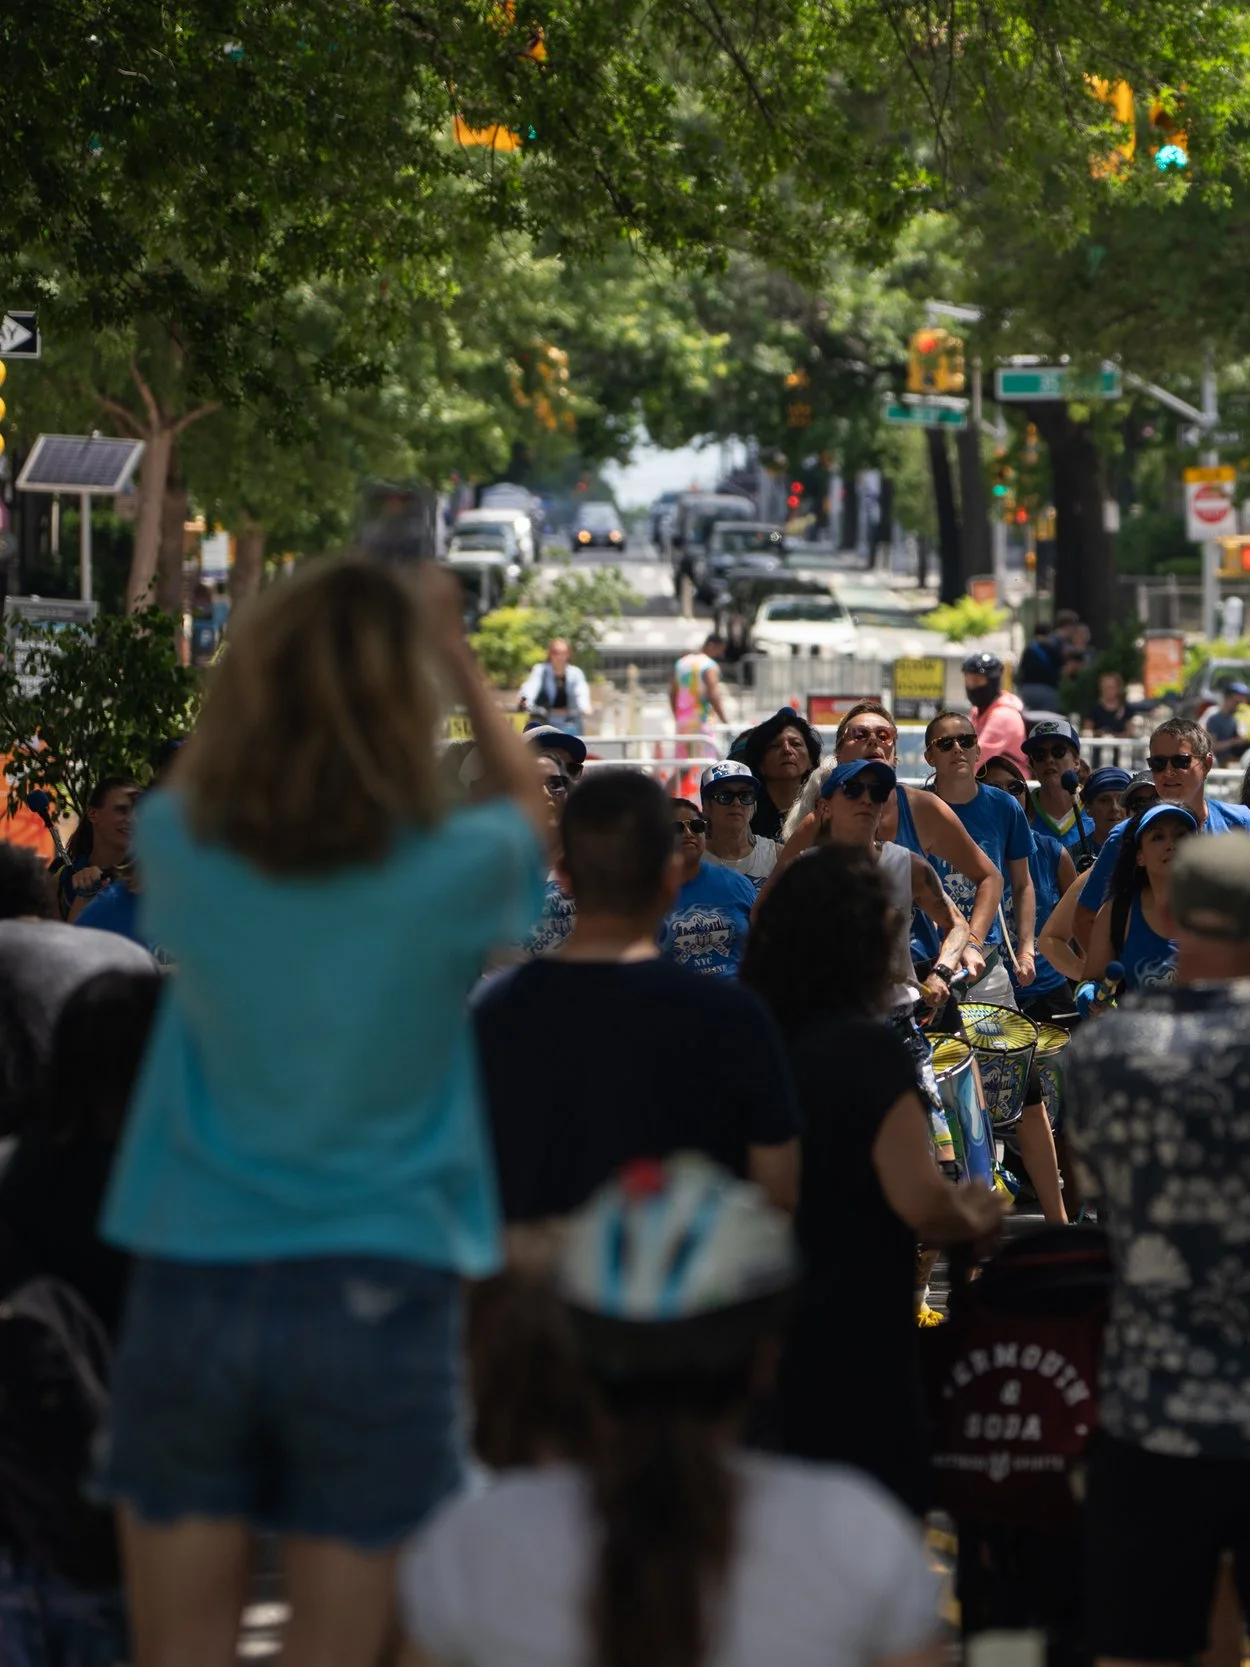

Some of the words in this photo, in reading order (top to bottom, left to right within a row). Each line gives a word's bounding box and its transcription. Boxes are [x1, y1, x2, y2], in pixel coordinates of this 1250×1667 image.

[693, 956, 713, 967] NYC
[941, 1341, 1091, 1408] ERMOUTH
[963, 1411, 1043, 1442] SODA
